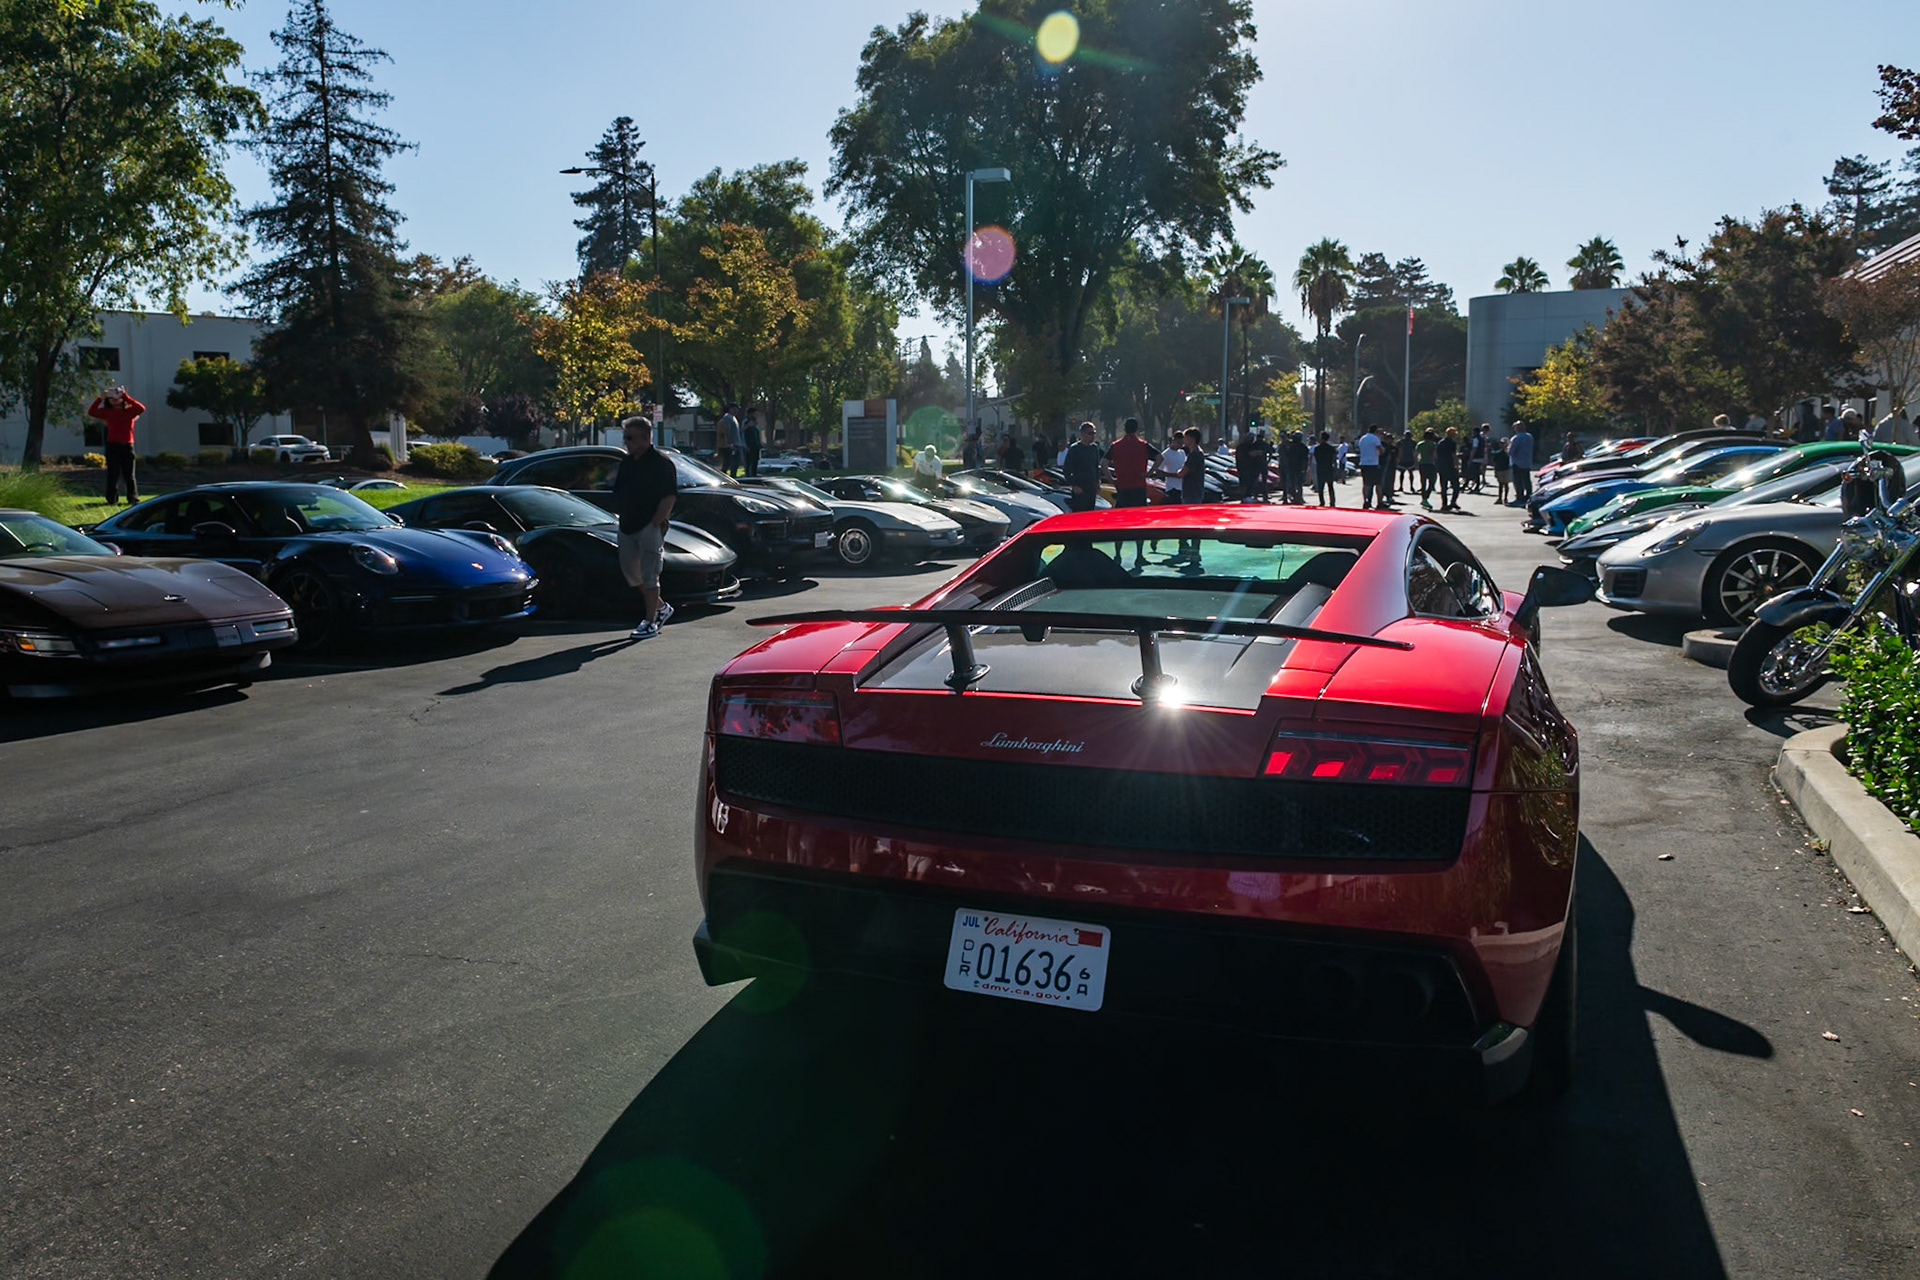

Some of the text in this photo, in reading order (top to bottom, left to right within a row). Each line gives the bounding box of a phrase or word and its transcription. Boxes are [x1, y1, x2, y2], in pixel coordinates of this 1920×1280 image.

[980, 732, 1085, 754] Lamborghini
[962, 915, 980, 928] JUL
[984, 917, 1079, 947] California
[976, 942, 1076, 993] 01636
[982, 983, 1061, 1001] dmv.ca.gov
